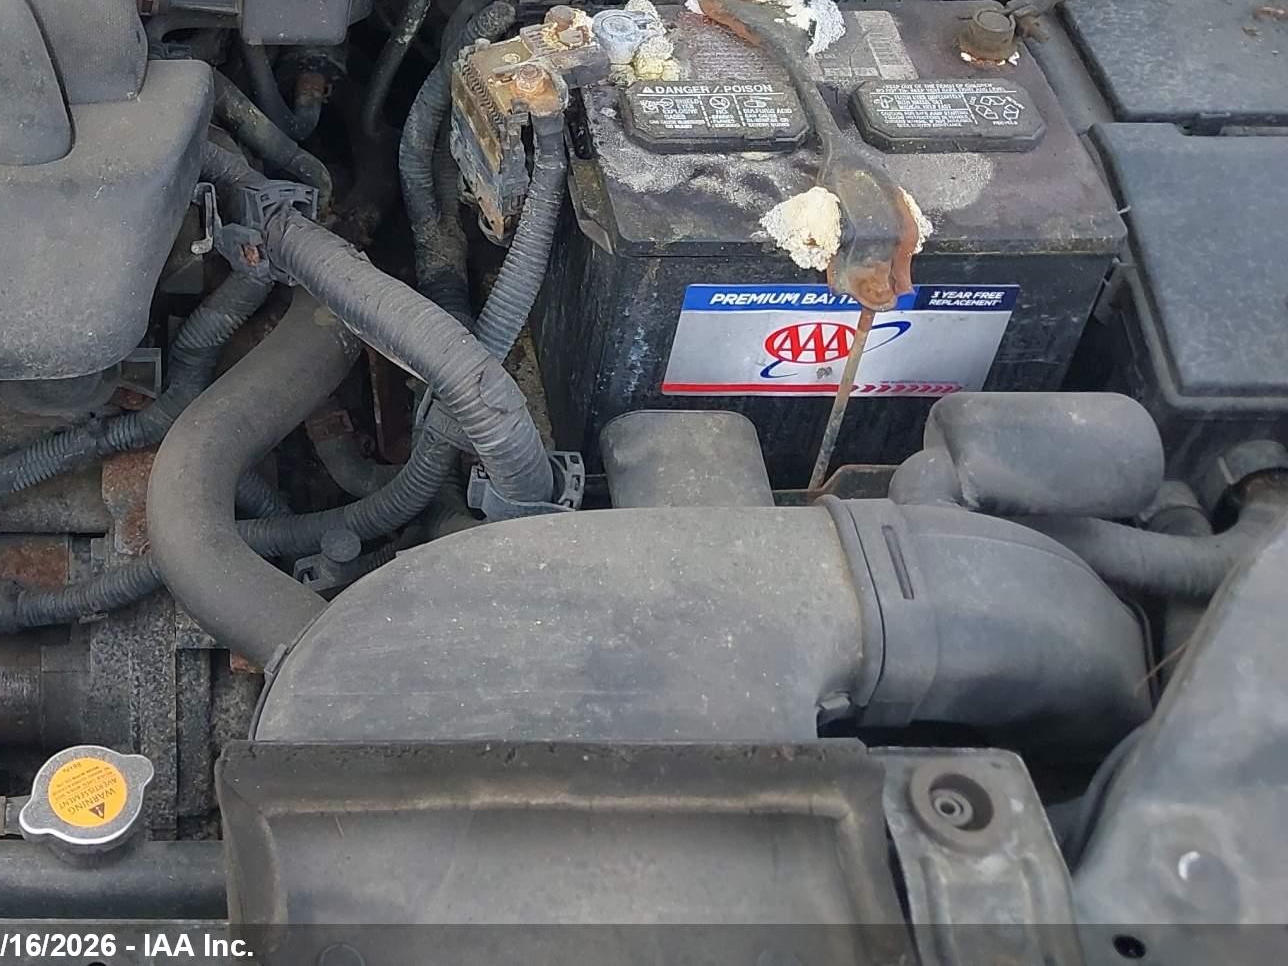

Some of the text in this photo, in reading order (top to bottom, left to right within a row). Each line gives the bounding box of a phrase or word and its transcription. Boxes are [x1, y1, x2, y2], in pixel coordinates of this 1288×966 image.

[655, 85, 709, 94] DANGER
[724, 84, 773, 93] POISON
[709, 292, 801, 305] PREMIUM
[931, 291, 1005, 299] 3 YEAR FREE
[772, 322, 851, 363] AAA
[67, 788, 117, 815] WARNING
